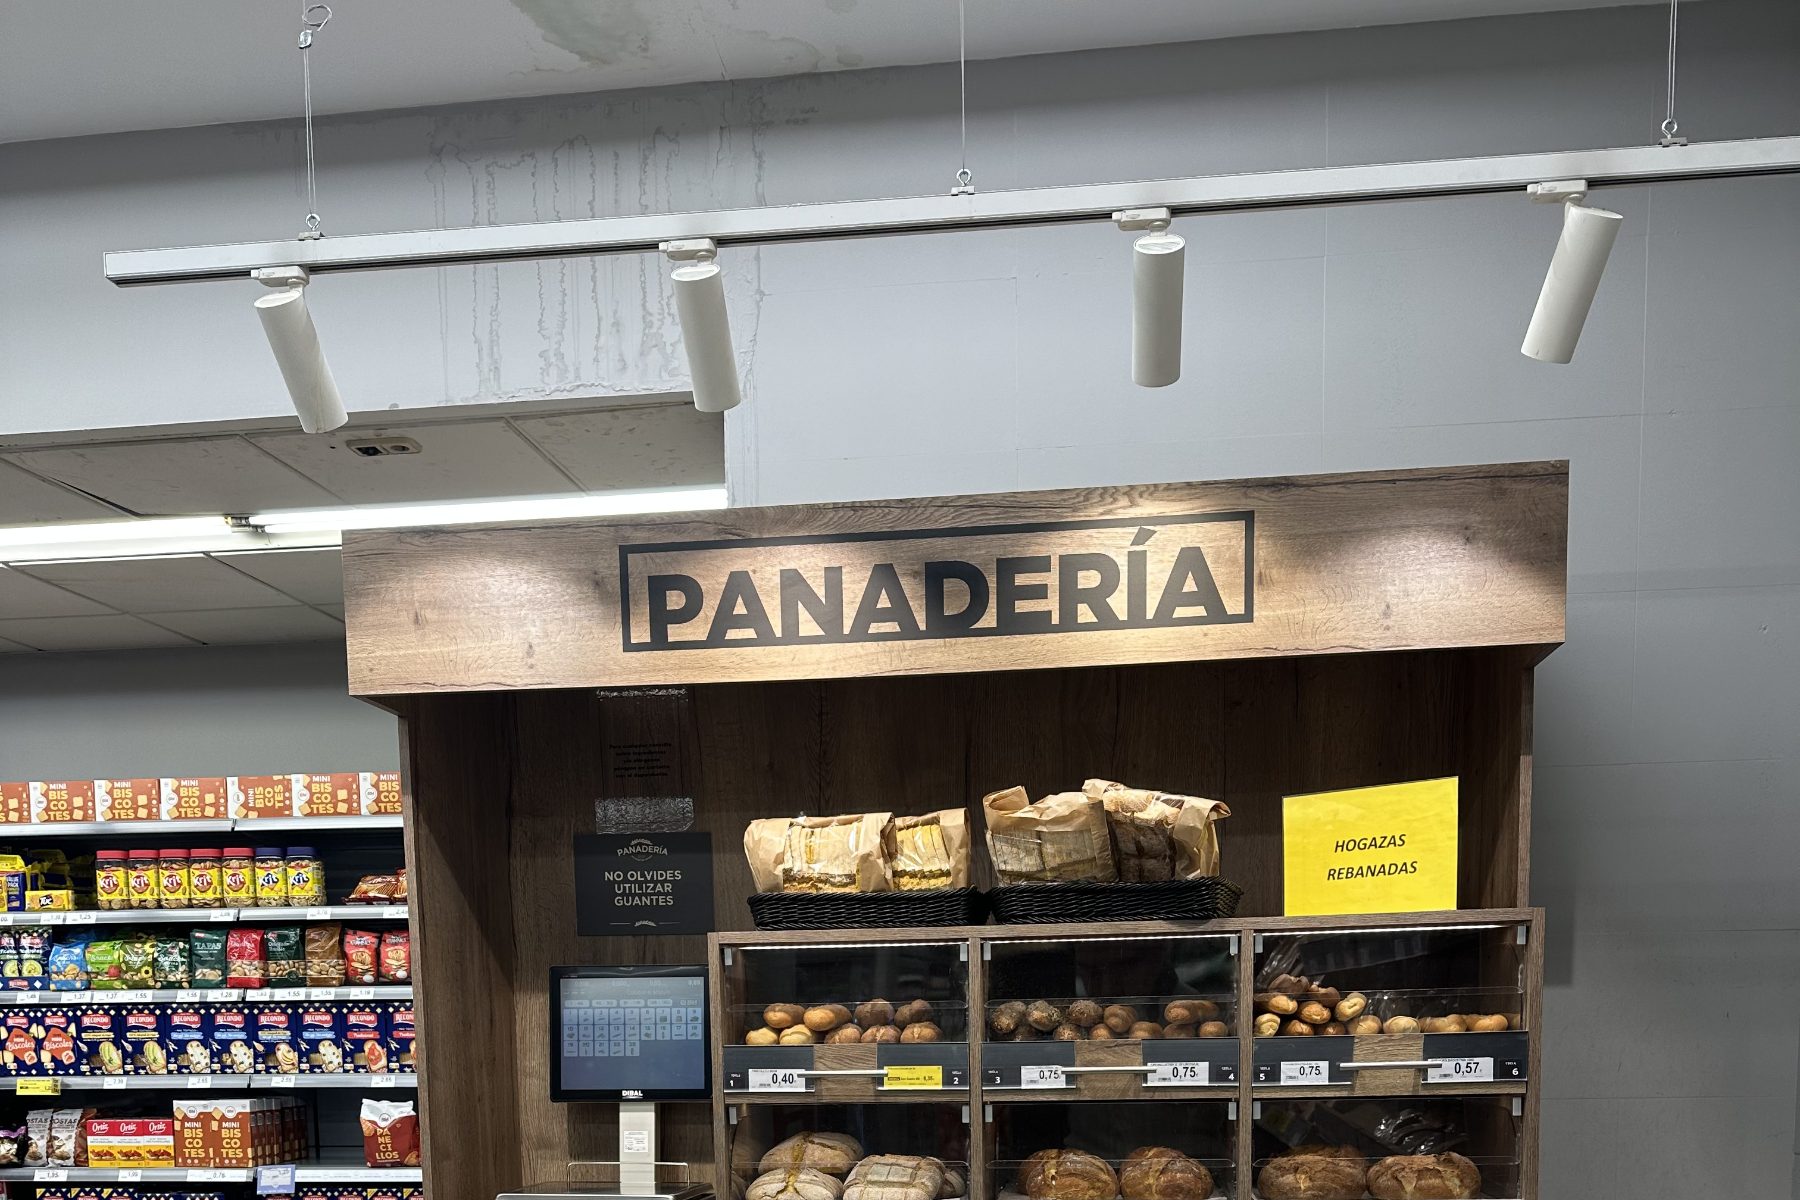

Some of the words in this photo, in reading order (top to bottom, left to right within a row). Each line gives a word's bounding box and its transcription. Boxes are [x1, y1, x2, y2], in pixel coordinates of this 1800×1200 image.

[648, 525, 1227, 644] PANADERÍA
[312, 783, 332, 792] BIS
[379, 782, 399, 791] BIS
[49, 791, 68, 800] BIS
[113, 789, 132, 798] BIS
[180, 787, 199, 796] BIS
[275, 784, 283, 808] TES
[255, 786, 264, 808] BIS
[265, 788, 273, 806] CO
[313, 793, 331, 802] CO
[381, 792, 398, 801] CO
[51, 801, 67, 810] CO
[115, 800, 131, 808] CO
[181, 798, 198, 807] CO
[311, 804, 334, 813] TES
[379, 803, 401, 812] TES
[48, 811, 70, 820] TES
[113, 810, 135, 819] TES
[179, 808, 201, 817] TES
[1334, 834, 1406, 853] HOGAZAS
[617, 845, 668, 856] PANADERÍA
[604, 872, 623, 880] NO
[628, 870, 681, 880] OLVIDES
[1327, 861, 1418, 881] REBANADAS
[615, 883, 672, 893] UTILIZAR
[615, 896, 673, 906] GUANTES
[1172, 1067, 1196, 1080] 0,75
[1299, 1066, 1321, 1077] 0,75
[1454, 1062, 1480, 1076] 0,57
[772, 1073, 794, 1086] 0,40
[996, 1076, 1000, 1084] 3
[1039, 1070, 1059, 1081] 0,75
[184, 1129, 203, 1137] BIS
[222, 1129, 241, 1137] BIS
[377, 1128, 390, 1136] PA
[185, 1139, 202, 1147] CO
[223, 1139, 240, 1147] CO
[183, 1149, 205, 1158] TES
[221, 1149, 243, 1158] TES
